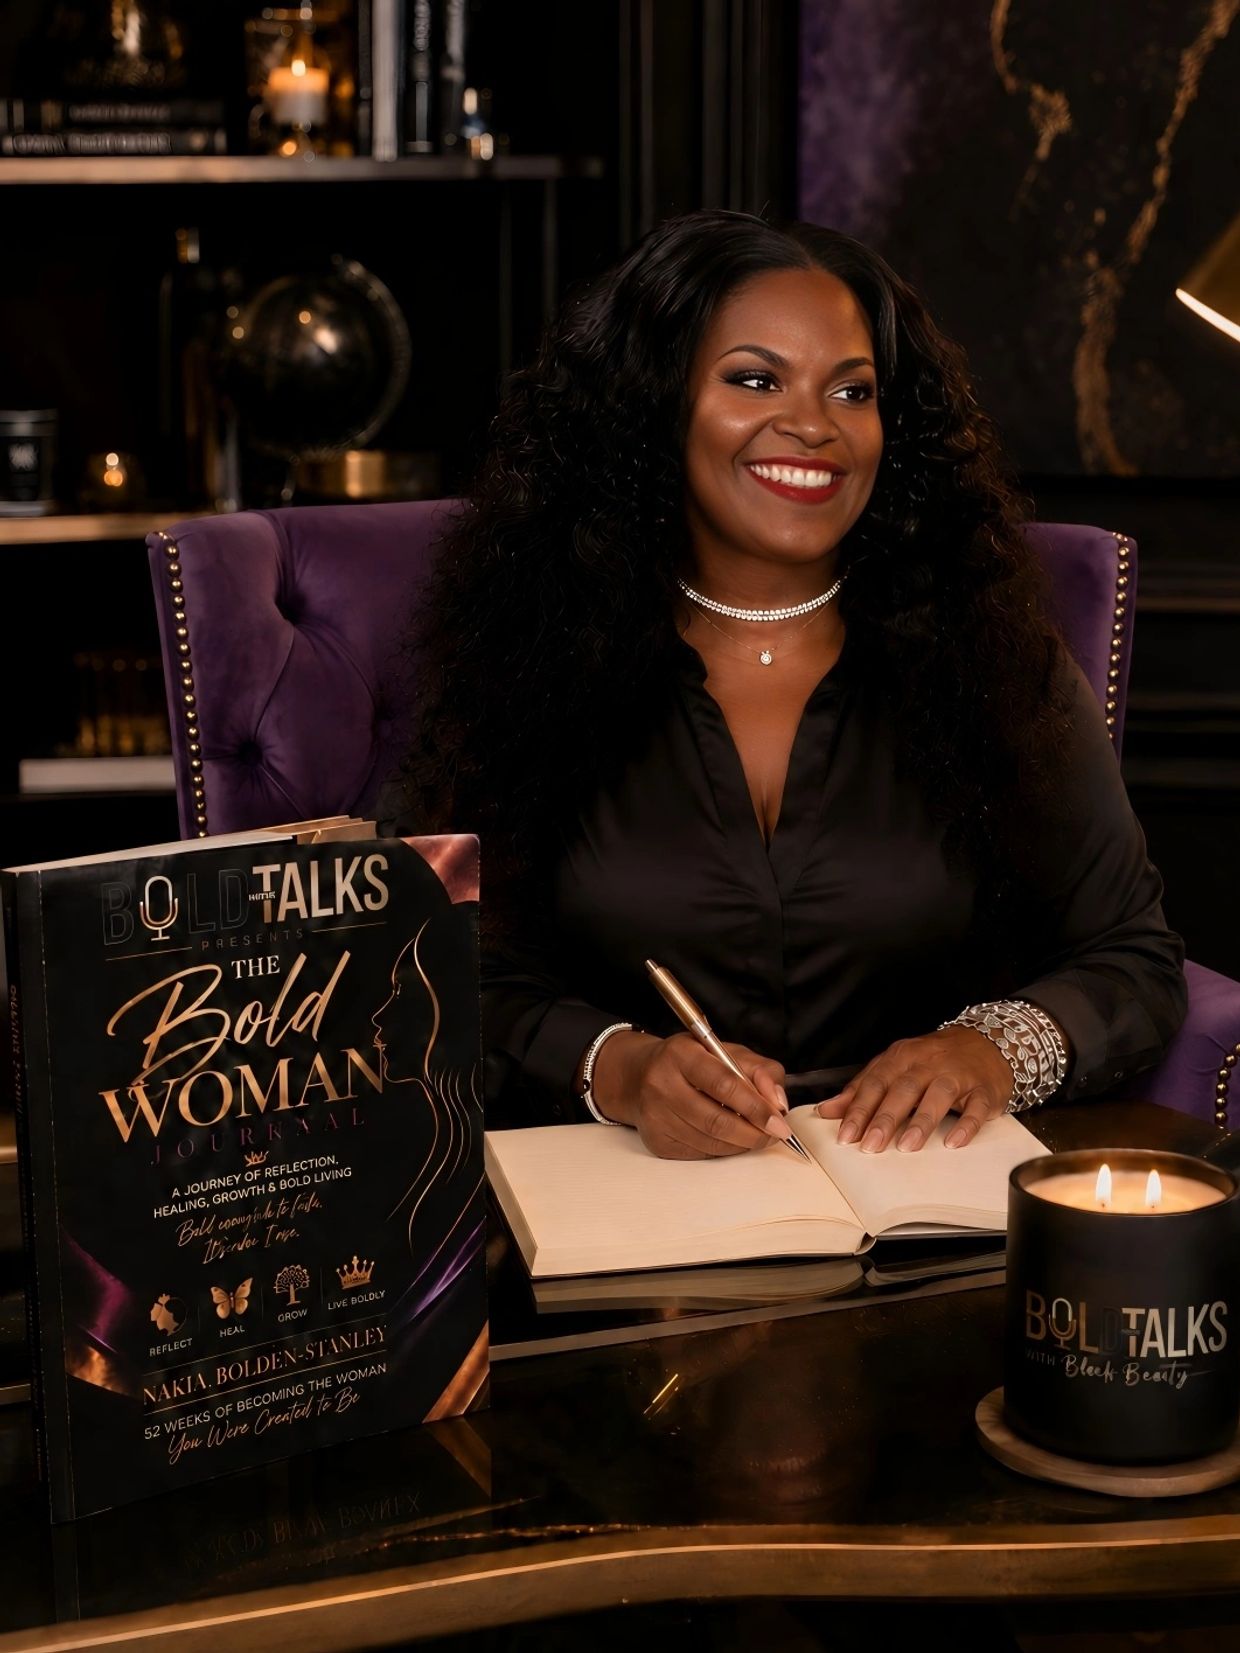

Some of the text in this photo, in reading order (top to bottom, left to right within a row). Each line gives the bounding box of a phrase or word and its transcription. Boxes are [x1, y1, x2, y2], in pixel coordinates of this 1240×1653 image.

[101, 853, 390, 946] BOLD TALKS
[201, 928, 304, 950] PRESENTS
[231, 954, 281, 980] THE
[106, 949, 351, 1090] Bold
[98, 1045, 385, 1143] WOMAN
[153, 1197, 210, 1219] HEALING,
[213, 1183, 266, 1205] GROWTH
[268, 1181, 276, 1193] &
[280, 1175, 311, 1191] BOLD
[314, 1167, 352, 1183] LIVING
[171, 1187, 180, 1199] A
[184, 1174, 240, 1196] JOURNEY
[244, 1169, 263, 1182] OF
[278, 1308, 308, 1323] GROW
[327, 1289, 386, 1311] LIVE BOLDLY
[1025, 1288, 1229, 1358] BOLD TALKS
[149, 1338, 193, 1357] REFLECT
[217, 1325, 386, 1385] BOLDEN-STANLEY
[219, 1325, 245, 1338] HEAL
[144, 1362, 387, 1439] 52 WEEKS OF BECOMING THE WOMAN
[168, 1432, 203, 1465] You
[207, 1420, 250, 1448] Were
[254, 1395, 313, 1435] Created
[334, 1386, 361, 1413] Be
